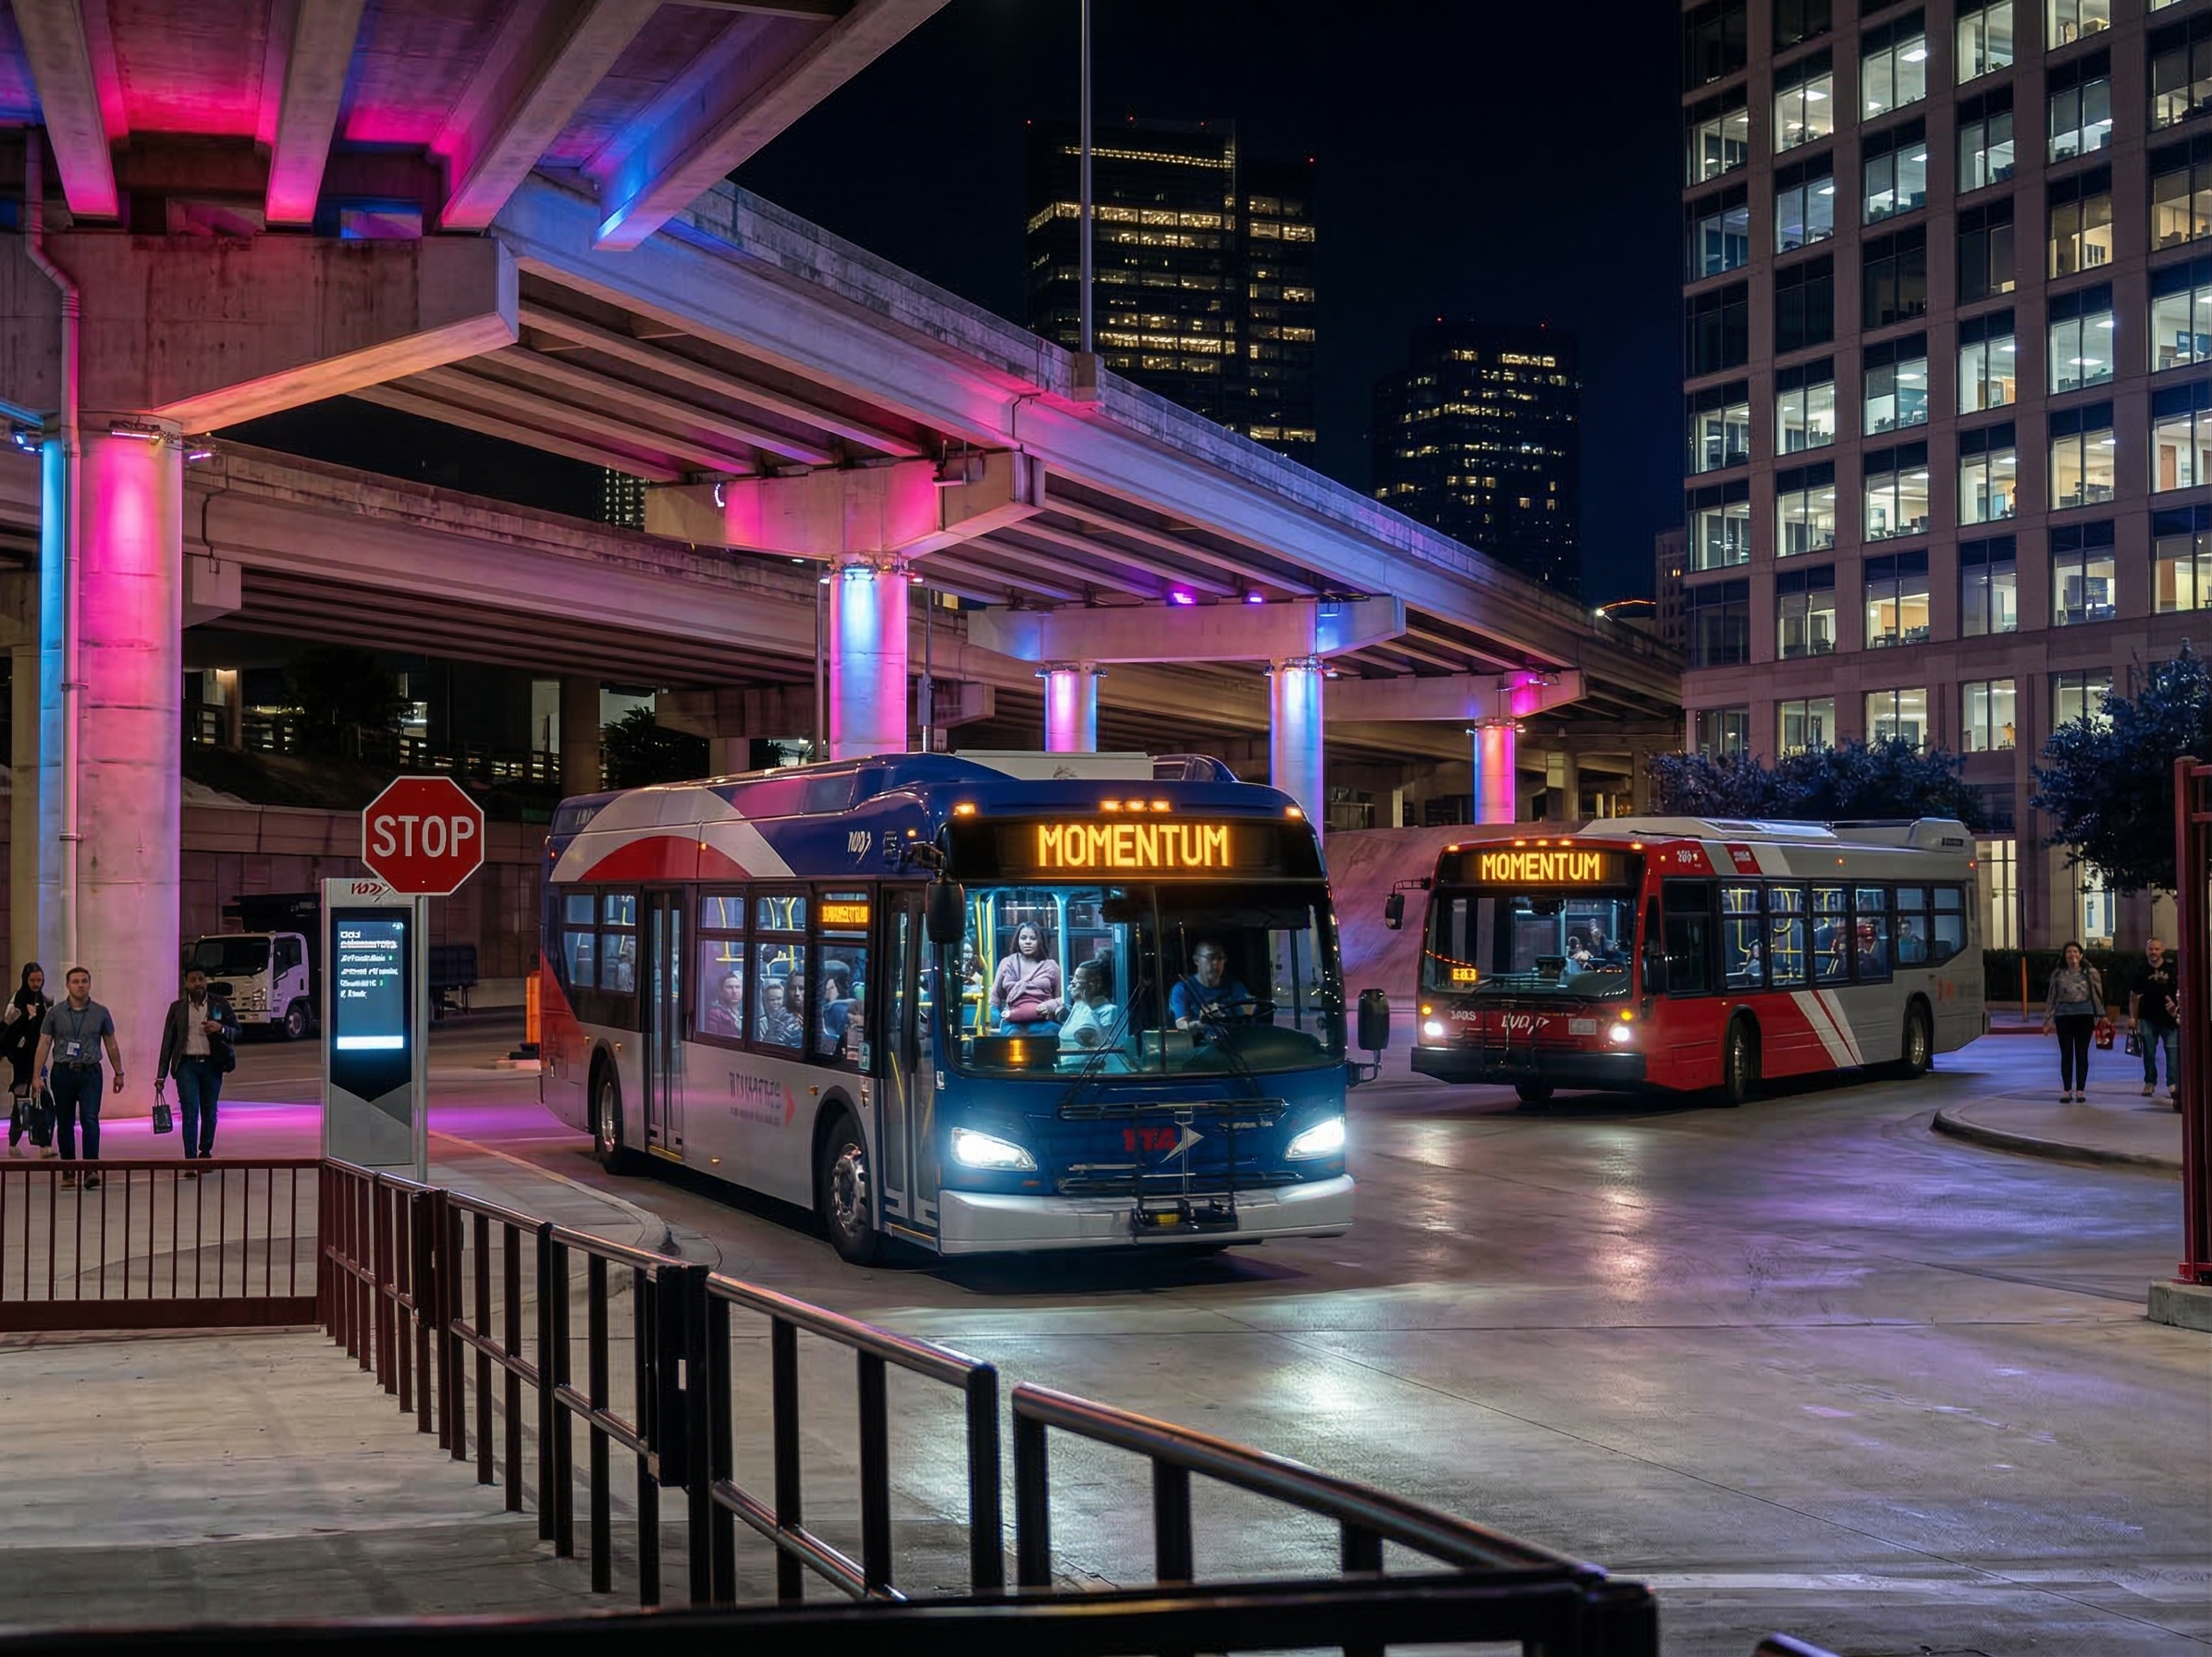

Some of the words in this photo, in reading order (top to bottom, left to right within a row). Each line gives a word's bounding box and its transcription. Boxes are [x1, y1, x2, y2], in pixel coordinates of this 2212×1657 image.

[373, 815, 474, 857] STOP
[1038, 824, 1228, 867] MOMENTUM
[1482, 853, 1601, 880] MOMENTUM
